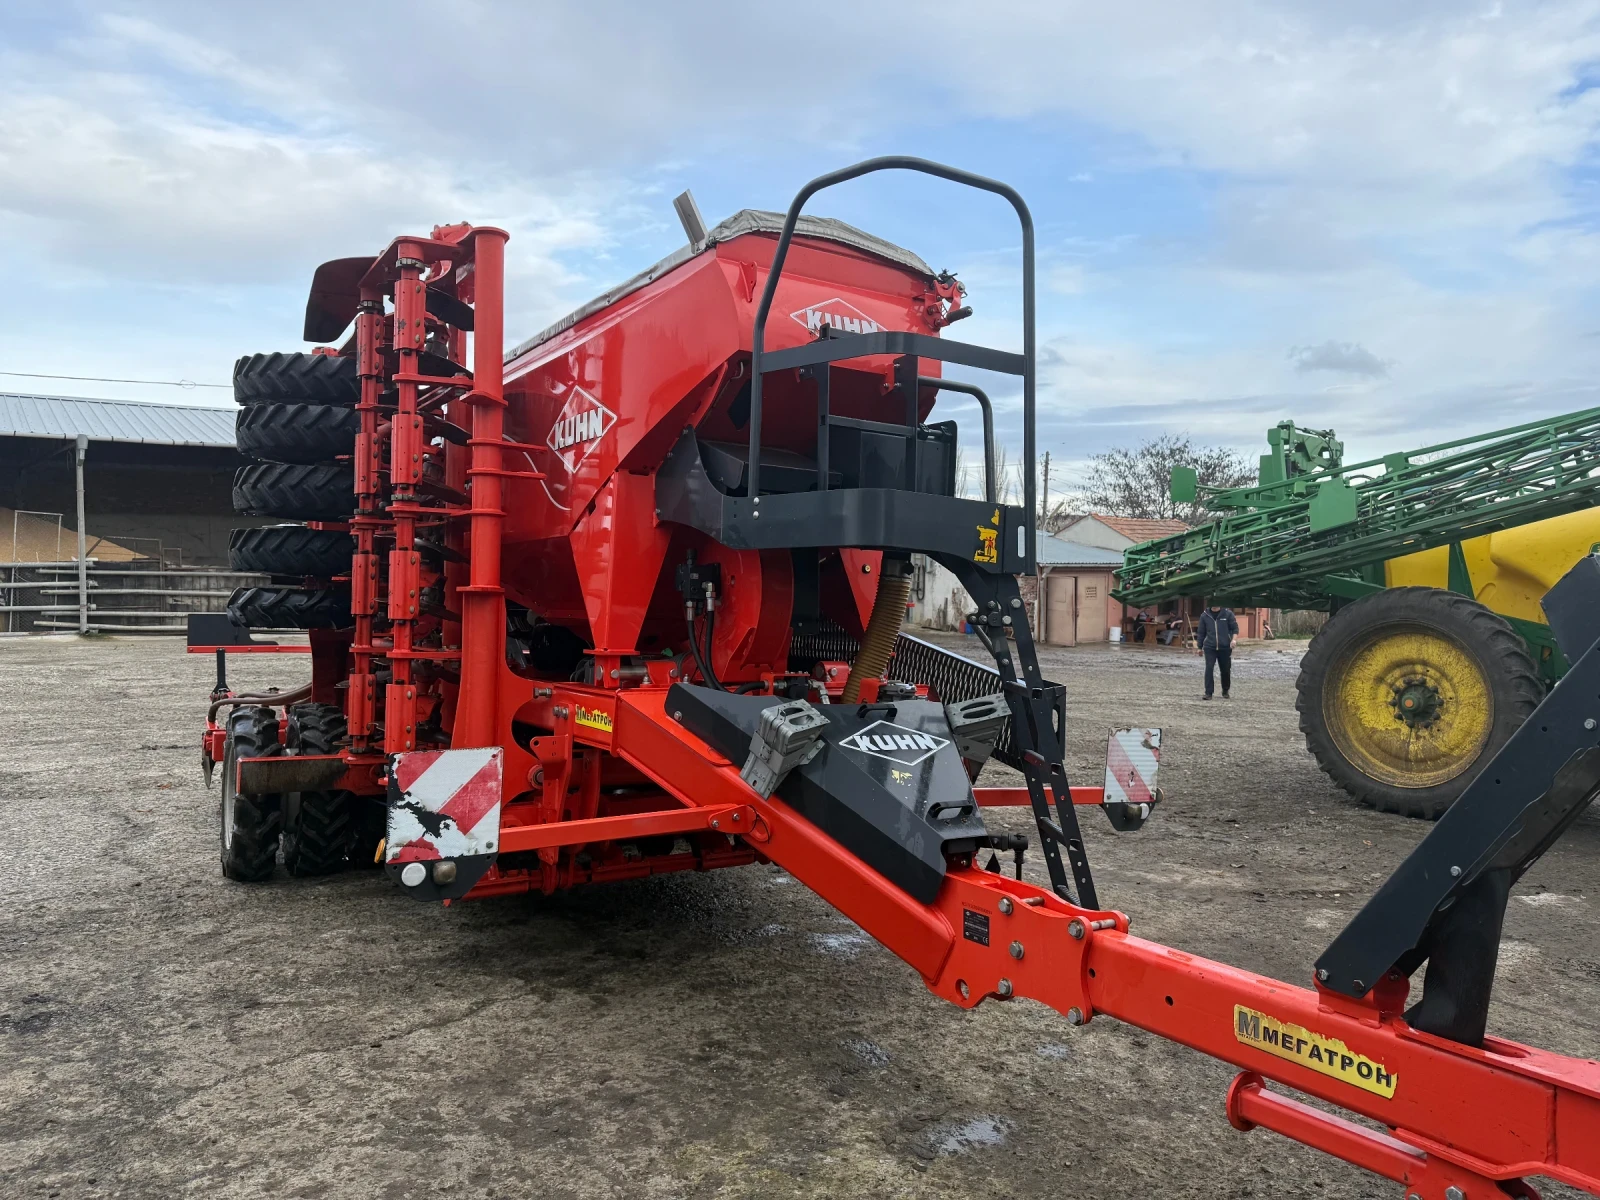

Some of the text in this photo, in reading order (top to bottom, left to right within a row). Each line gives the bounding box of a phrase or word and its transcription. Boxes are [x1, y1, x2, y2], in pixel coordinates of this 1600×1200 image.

[806, 309, 878, 334] KUHN
[555, 407, 603, 451] KUHN
[853, 734, 938, 752] KUHN
[1262, 1025, 1393, 1089] МЕГАТРОН
